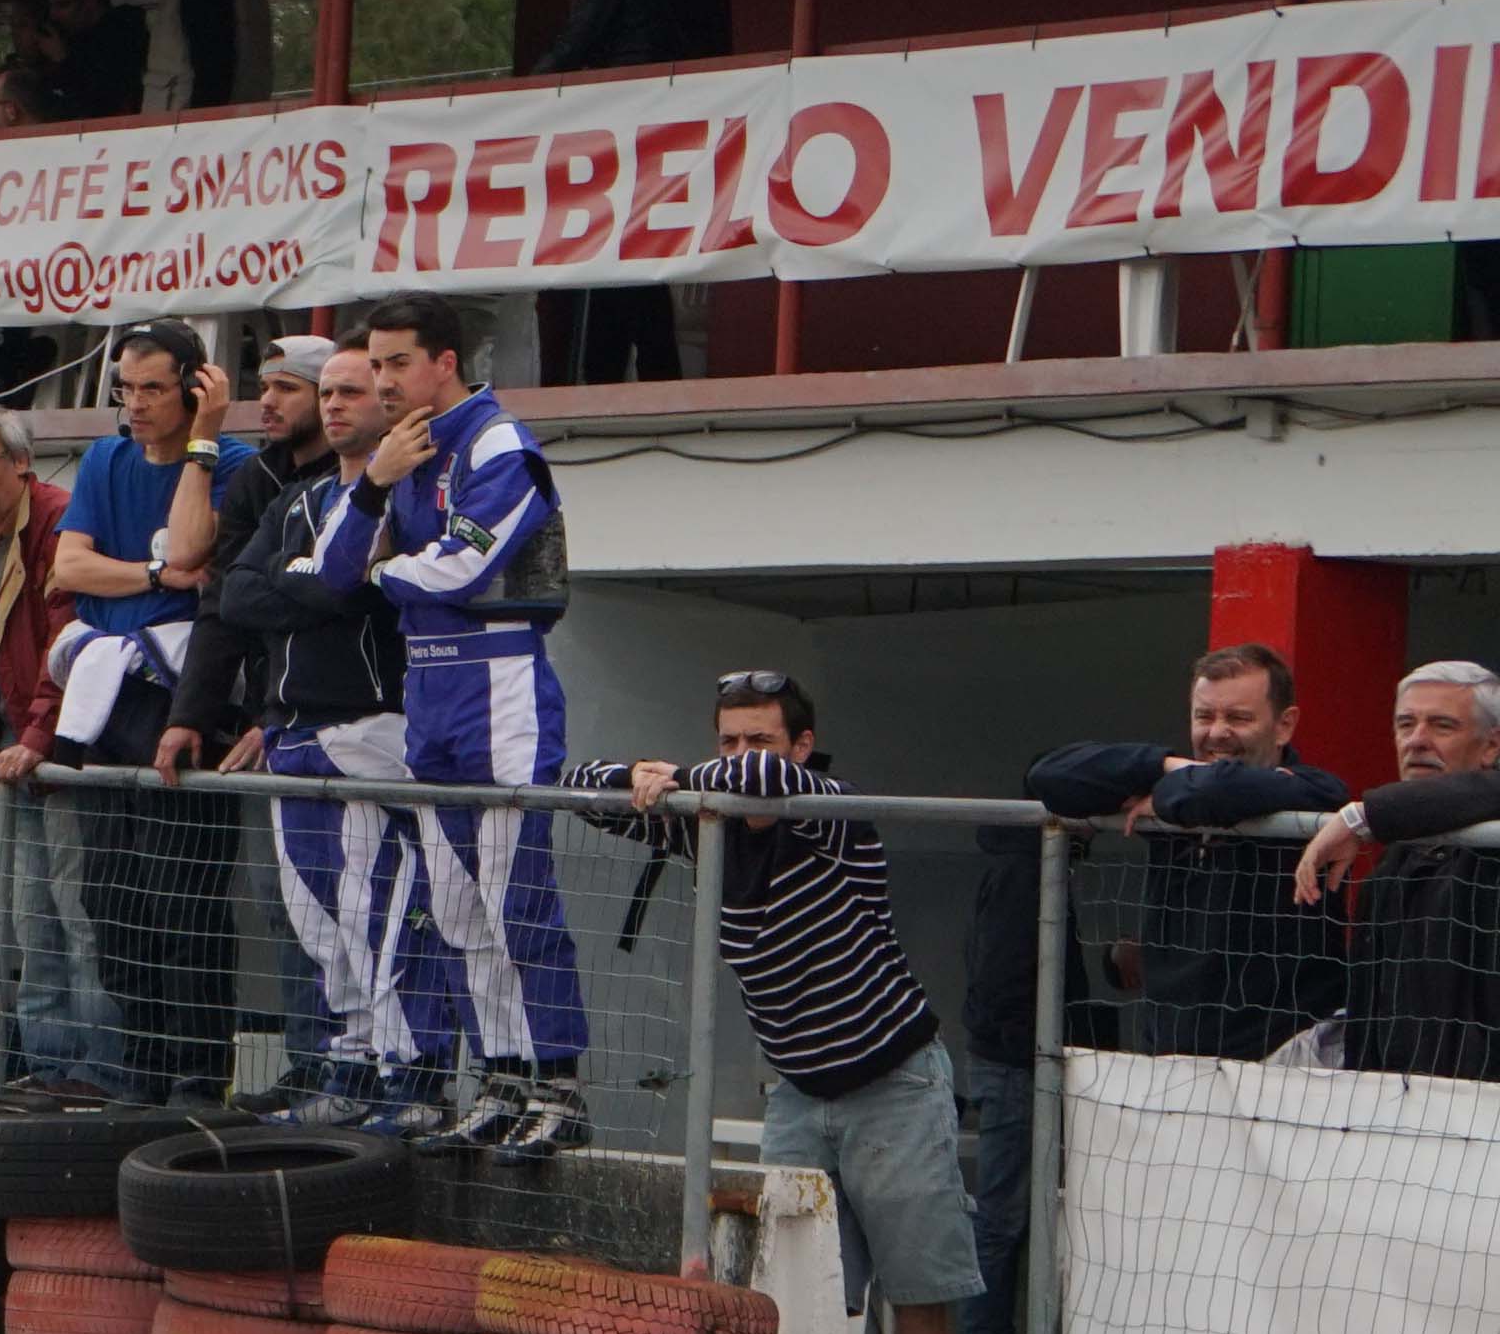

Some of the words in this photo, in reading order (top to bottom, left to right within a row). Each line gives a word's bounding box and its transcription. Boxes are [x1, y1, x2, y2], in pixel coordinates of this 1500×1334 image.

[121, 160, 152, 216] E
[166, 139, 347, 214] SNACKS
[373, 102, 891, 273] REBELO
[429, 644, 459, 658] Sousa
